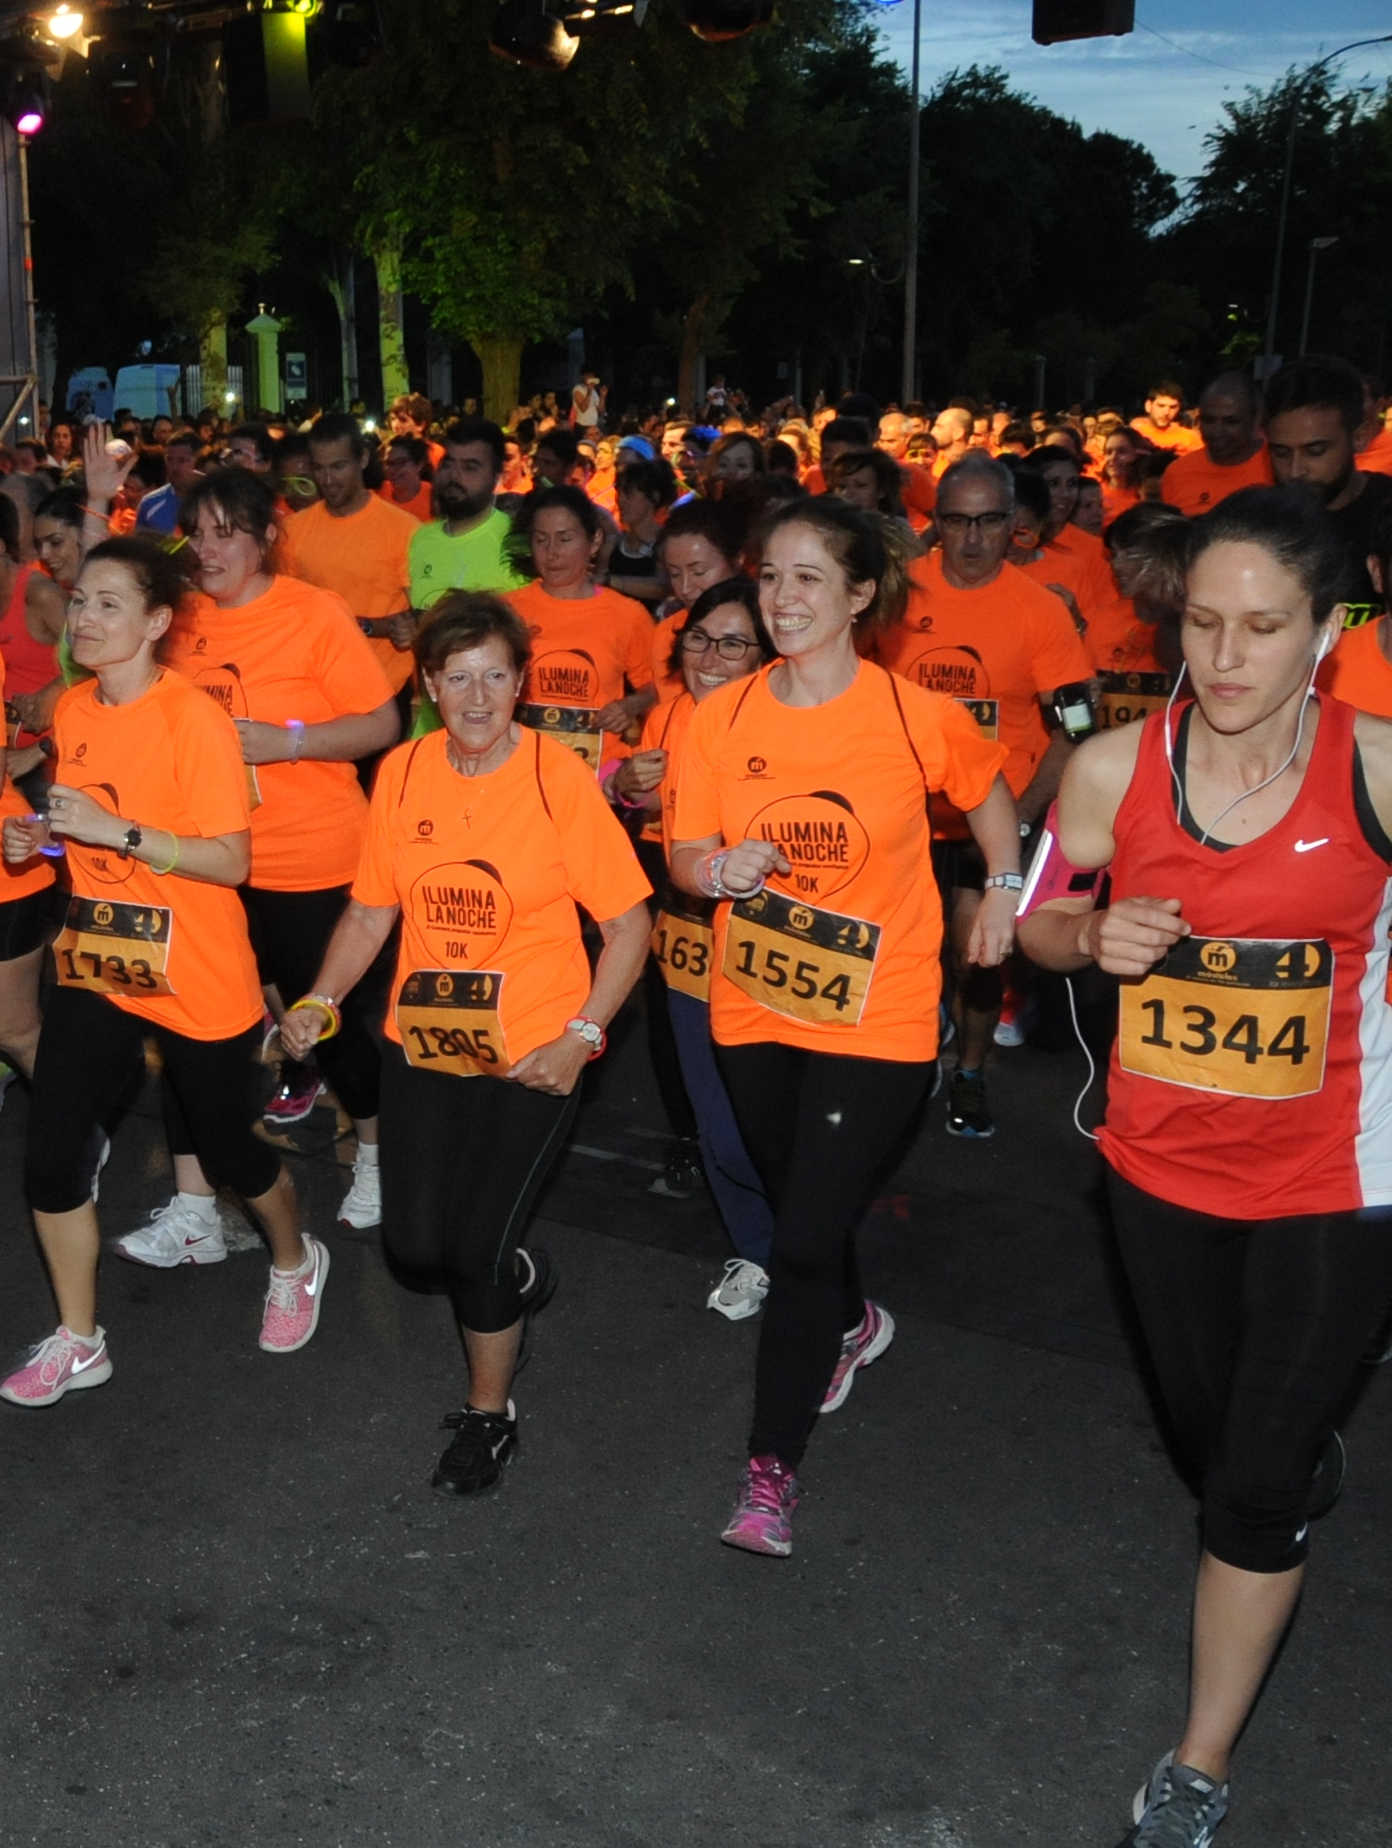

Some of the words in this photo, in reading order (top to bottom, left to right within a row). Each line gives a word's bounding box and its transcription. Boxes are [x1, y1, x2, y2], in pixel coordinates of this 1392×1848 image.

[538, 667, 589, 684] ILUMINA
[918, 662, 976, 681] ILUMINA
[761, 821, 849, 843] ILUMINA
[795, 874, 819, 893] 10K
[421, 885, 496, 910] ILUMINA
[445, 941, 469, 959] 10K
[62, 948, 158, 989] 1733
[736, 940, 851, 1012] 1554
[1141, 998, 1310, 1065] 1344
[408, 1026, 498, 1064] 1805
